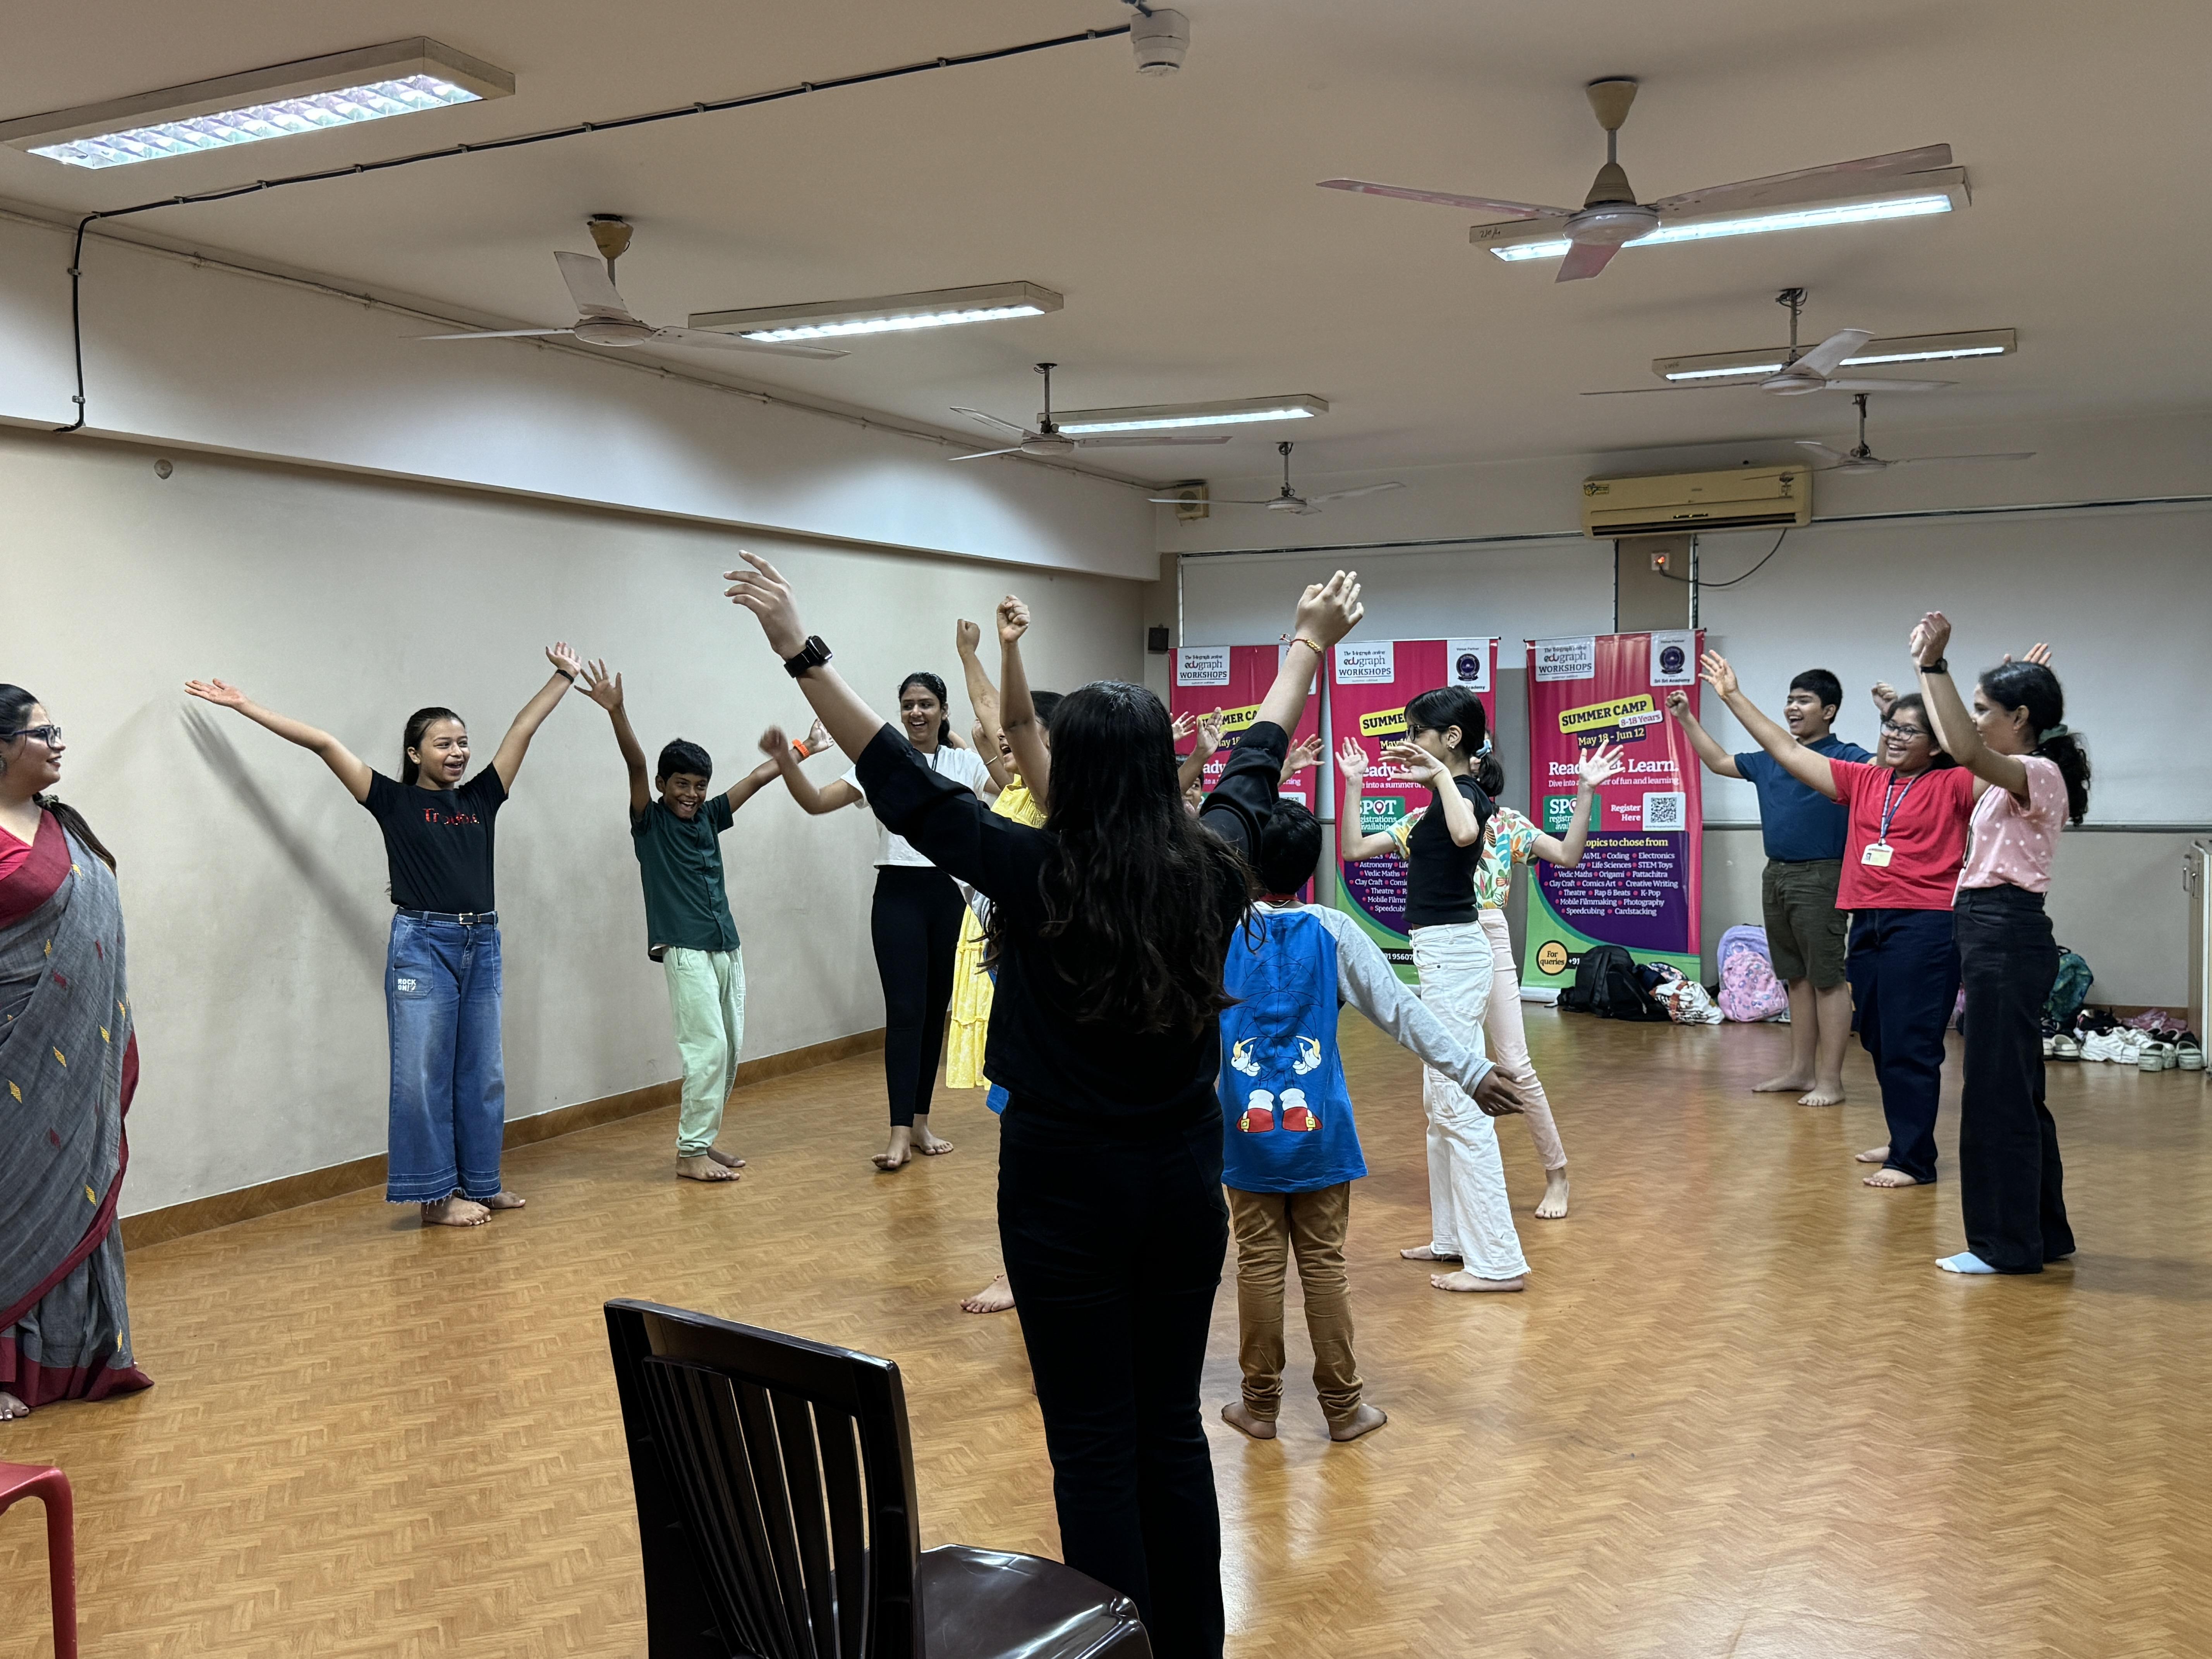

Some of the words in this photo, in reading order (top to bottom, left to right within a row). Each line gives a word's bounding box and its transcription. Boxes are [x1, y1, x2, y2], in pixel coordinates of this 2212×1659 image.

[1539, 663, 1592, 673] WORKSHOPS
[1561, 707, 1611, 726] SUMMER
[1613, 701, 1647, 716] CAMP
[1363, 713, 1407, 729] SUMME
[1621, 717, 1637, 726] 8-18
[1638, 713, 1661, 723] Years
[1578, 737, 1596, 746] May
[1599, 733, 1608, 742] 18
[1616, 730, 1632, 742] Jun
[1634, 728, 1645, 737] 12
[1203, 760, 1226, 777] ady
[1628, 759, 1679, 773] Learn.
[1611, 777, 1620, 785] of
[1620, 776, 1632, 785] fun
[1648, 776, 1679, 786] learning
[1611, 804, 1641, 813] Register
[1585, 838, 1608, 848] opics
[1609, 838, 1618, 847] to
[1619, 838, 1644, 847] chose
[1645, 837, 1668, 846] from
[1607, 852, 1630, 860] Coding
[1658, 861, 1673, 870] Toys
[1599, 871, 1625, 879] Origami
[1653, 881, 1678, 889] Writing
[1580, 898, 1617, 907] Filmmaking
[1623, 899, 1665, 907] Photography
[1375, 905, 1405, 913] Speedcubi
[1566, 908, 1605, 916] Speedcubing
[1614, 908, 1657, 916] Cardstacking
[1540, 958, 1565, 966] queries
